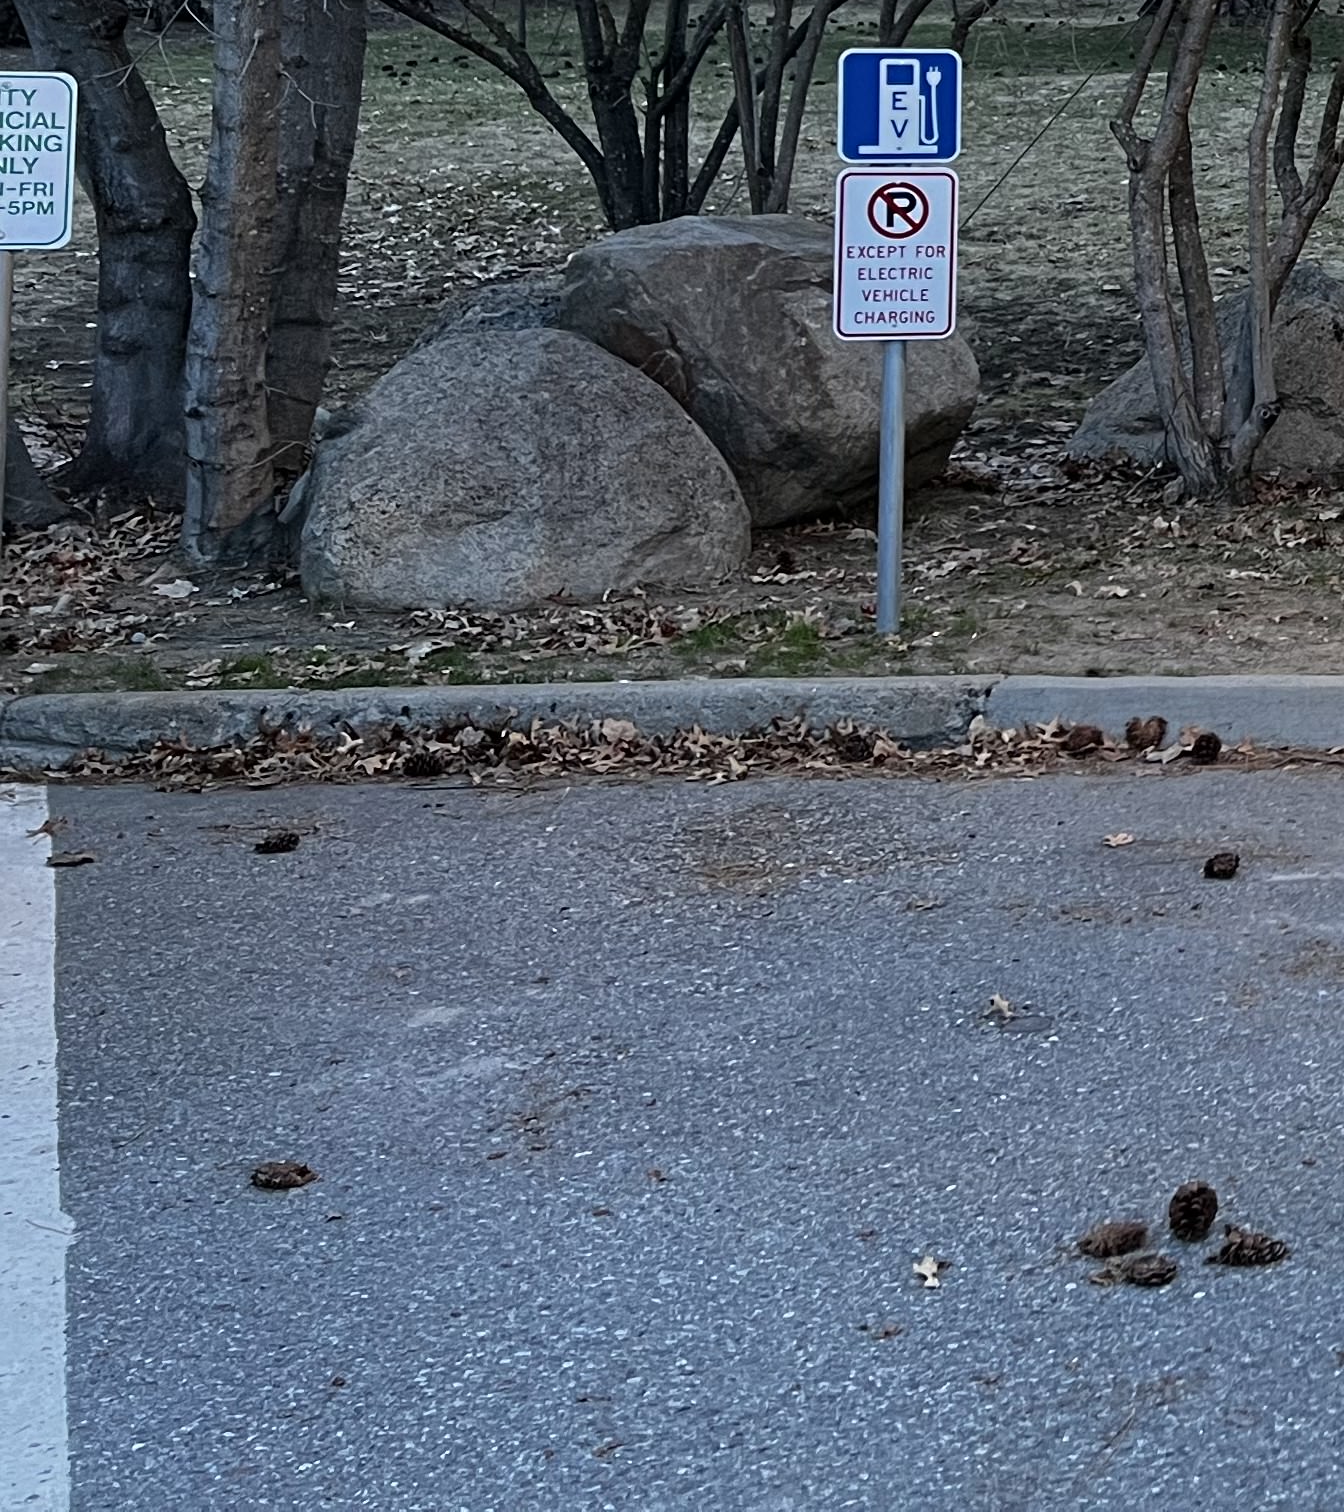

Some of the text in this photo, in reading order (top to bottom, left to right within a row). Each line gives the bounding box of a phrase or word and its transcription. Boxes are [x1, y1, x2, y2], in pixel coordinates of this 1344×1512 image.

[0, 89, 38, 106] TY
[0, 182, 54, 197] -FRI
[846, 245, 946, 259] EXCEPT FOR
[857, 267, 934, 281] ELECTRIC
[862, 289, 929, 302] VEHICLE
[854, 311, 936, 324] CHARGING
